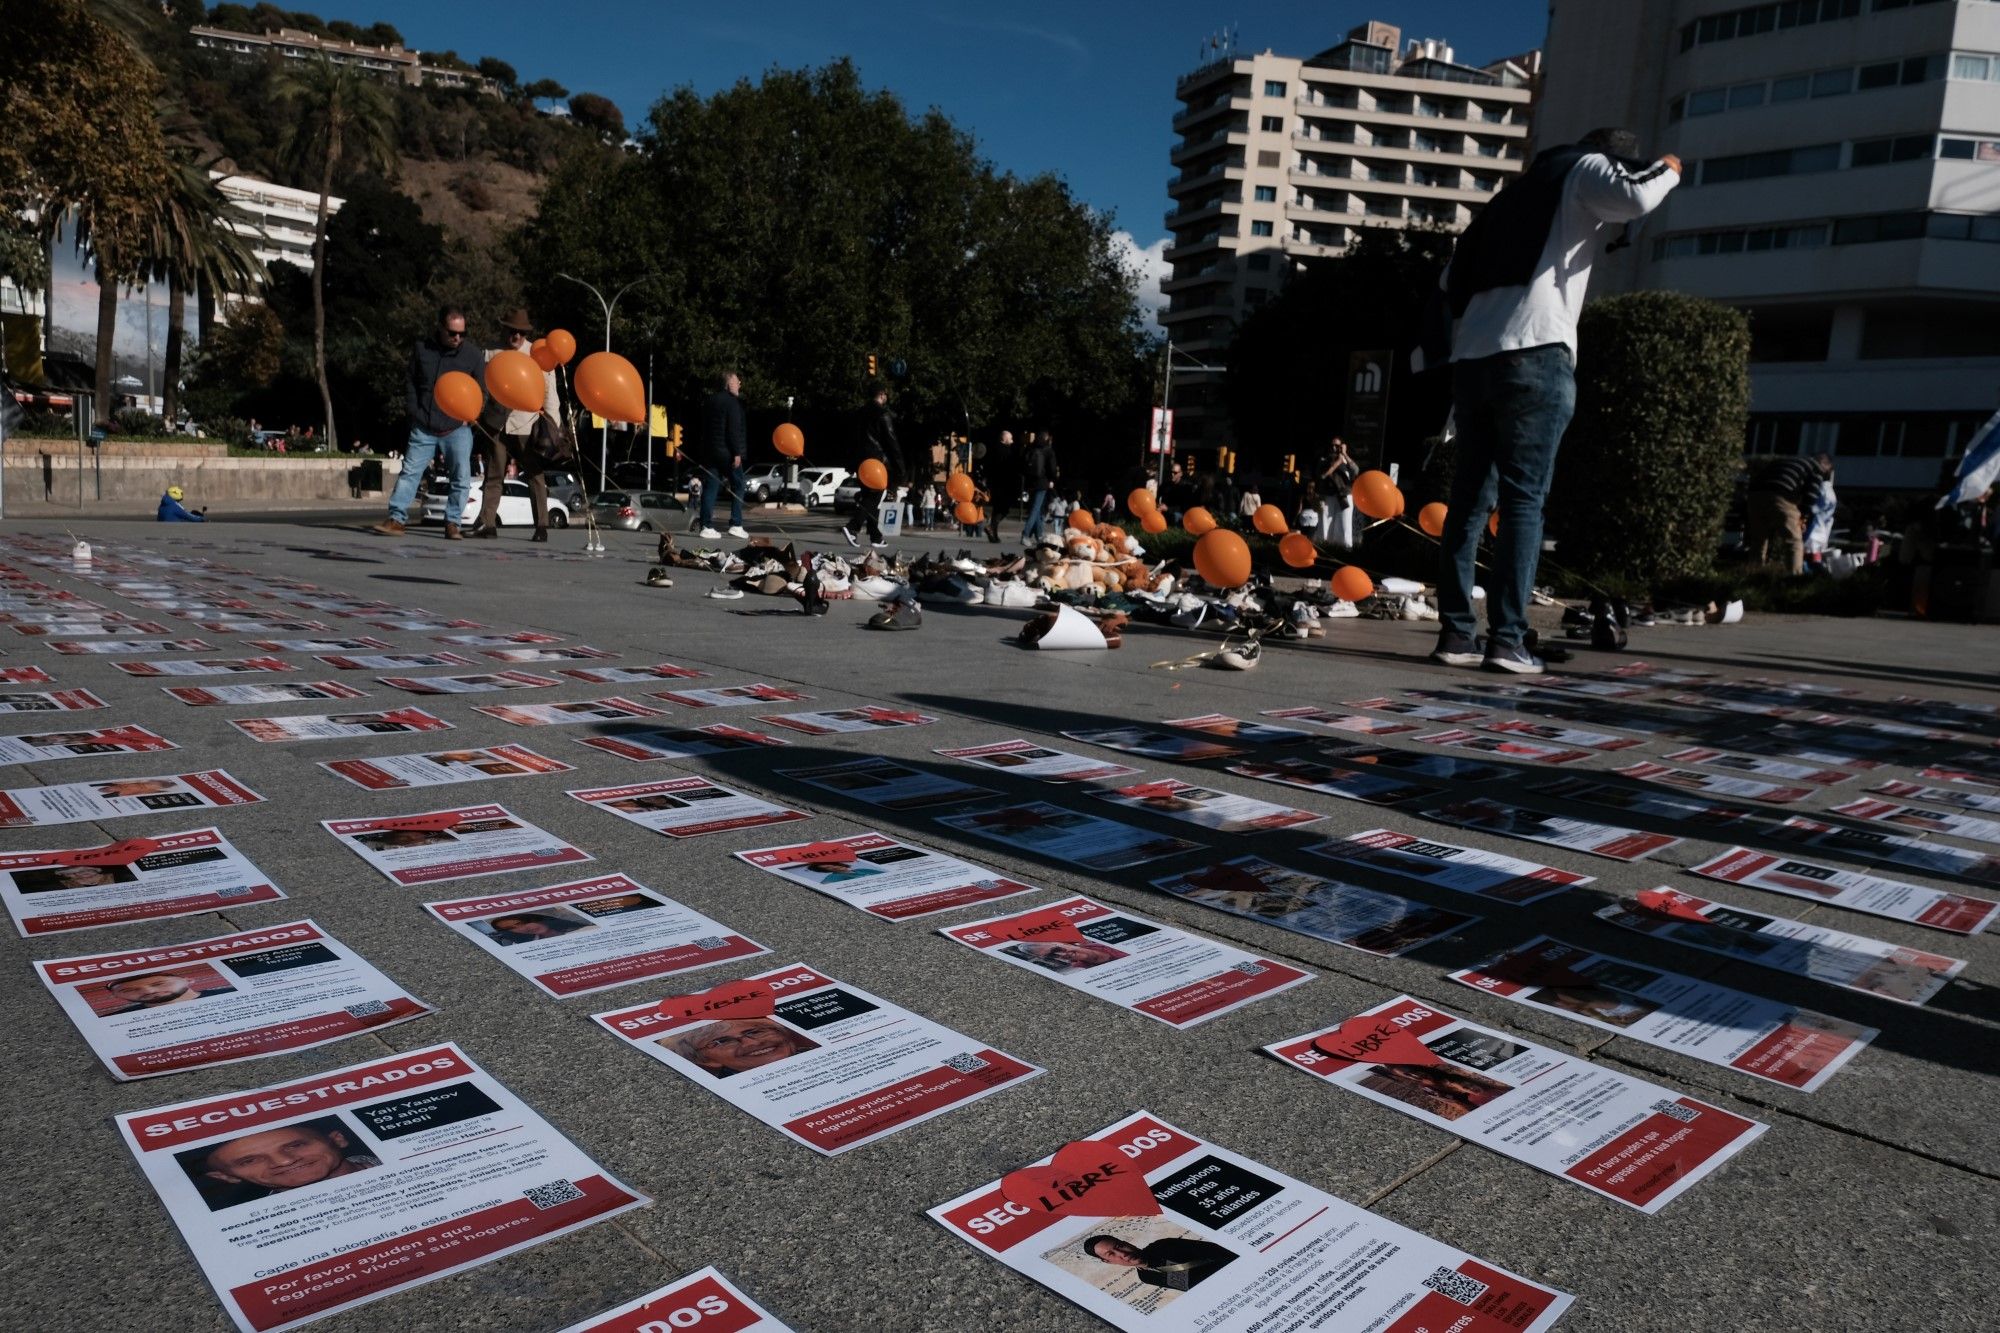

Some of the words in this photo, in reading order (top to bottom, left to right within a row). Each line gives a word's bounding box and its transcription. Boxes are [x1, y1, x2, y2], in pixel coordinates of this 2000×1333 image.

[445, 881, 627, 914] SECUESTRADOS
[55, 928, 311, 978] SECUESTRADOS
[774, 1001, 809, 1012] Vivian
[809, 1000, 838, 1010] años
[809, 1005, 845, 1017] Israeli
[142, 1050, 206, 1066] regresen
[211, 1041, 248, 1051] vivos
[168, 1044, 205, 1054] favor
[209, 1033, 259, 1046] ayuden
[144, 1057, 455, 1137] SECUESTRADOS
[366, 1105, 399, 1117] Yair
[401, 1090, 460, 1108] Yaakov
[397, 1104, 437, 1117] años
[805, 1117, 829, 1128] Por
[826, 1107, 856, 1119] favor
[855, 1092, 897, 1110] ayuden
[903, 1083, 925, 1092] que
[380, 1114, 431, 1130] Israeli
[818, 1114, 867, 1134] regresen
[864, 1102, 895, 1115] vivos
[903, 1092, 923, 1101] sus
[432, 1150, 476, 1165] inocentes
[1585, 1166, 1606, 1177] Por
[1598, 1155, 1622, 1168] favor
[1614, 1140, 1646, 1158] ayuden
[1643, 1131, 1662, 1141] que
[1606, 1164, 1641, 1185] regresen
[1630, 1152, 1655, 1165] vivos
[1654, 1142, 1670, 1151] sus
[405, 1177, 465, 1198] maltratados,
[1153, 1164, 1221, 1201] Natthaphong
[1187, 1180, 1218, 1196] Pinta
[1198, 1197, 1216, 1208] 35
[1211, 1184, 1240, 1200] años
[229, 1233, 252, 1242] Más
[303, 1206, 349, 1222] mujeres,
[351, 1191, 396, 1206] hombres
[1209, 1189, 1261, 1218] Tailandes
[221, 1207, 296, 1231] secuestrados
[1223, 1209, 1265, 1234] Secuestrado
[254, 1260, 298, 1279] Capte
[303, 1252, 329, 1263] una
[400, 1223, 417, 1232] de
[419, 1214, 447, 1226] este
[450, 1198, 502, 1218] mensaje
[256, 1226, 320, 1248] asesinados
[264, 1278, 299, 1294] Por
[304, 1261, 353, 1281] favor
[357, 1239, 422, 1266] ayuden
[440, 1225, 473, 1239] que
[271, 1273, 357, 1306] regresen
[360, 1254, 409, 1274] vivos
[429, 1239, 460, 1252] sus
[462, 1213, 535, 1242] hogares.
[1241, 1281, 1260, 1293] cerca
[1275, 1255, 1297, 1268] civiles
[1293, 1237, 1323, 1256] inocentes
[1334, 1257, 1369, 1282] maltratados,
[1281, 1318, 1304, 1333] inados
[1306, 1289, 1343, 1316] brutalmente
[1339, 1269, 1371, 1291] separados
[1385, 1246, 1401, 1257] seres
[1262, 1304, 1290, 1324] mujeres,
[1286, 1284, 1314, 1304] hombres
[1307, 1308, 1338, 1329] queridos
[1334, 1301, 1348, 1310] por
